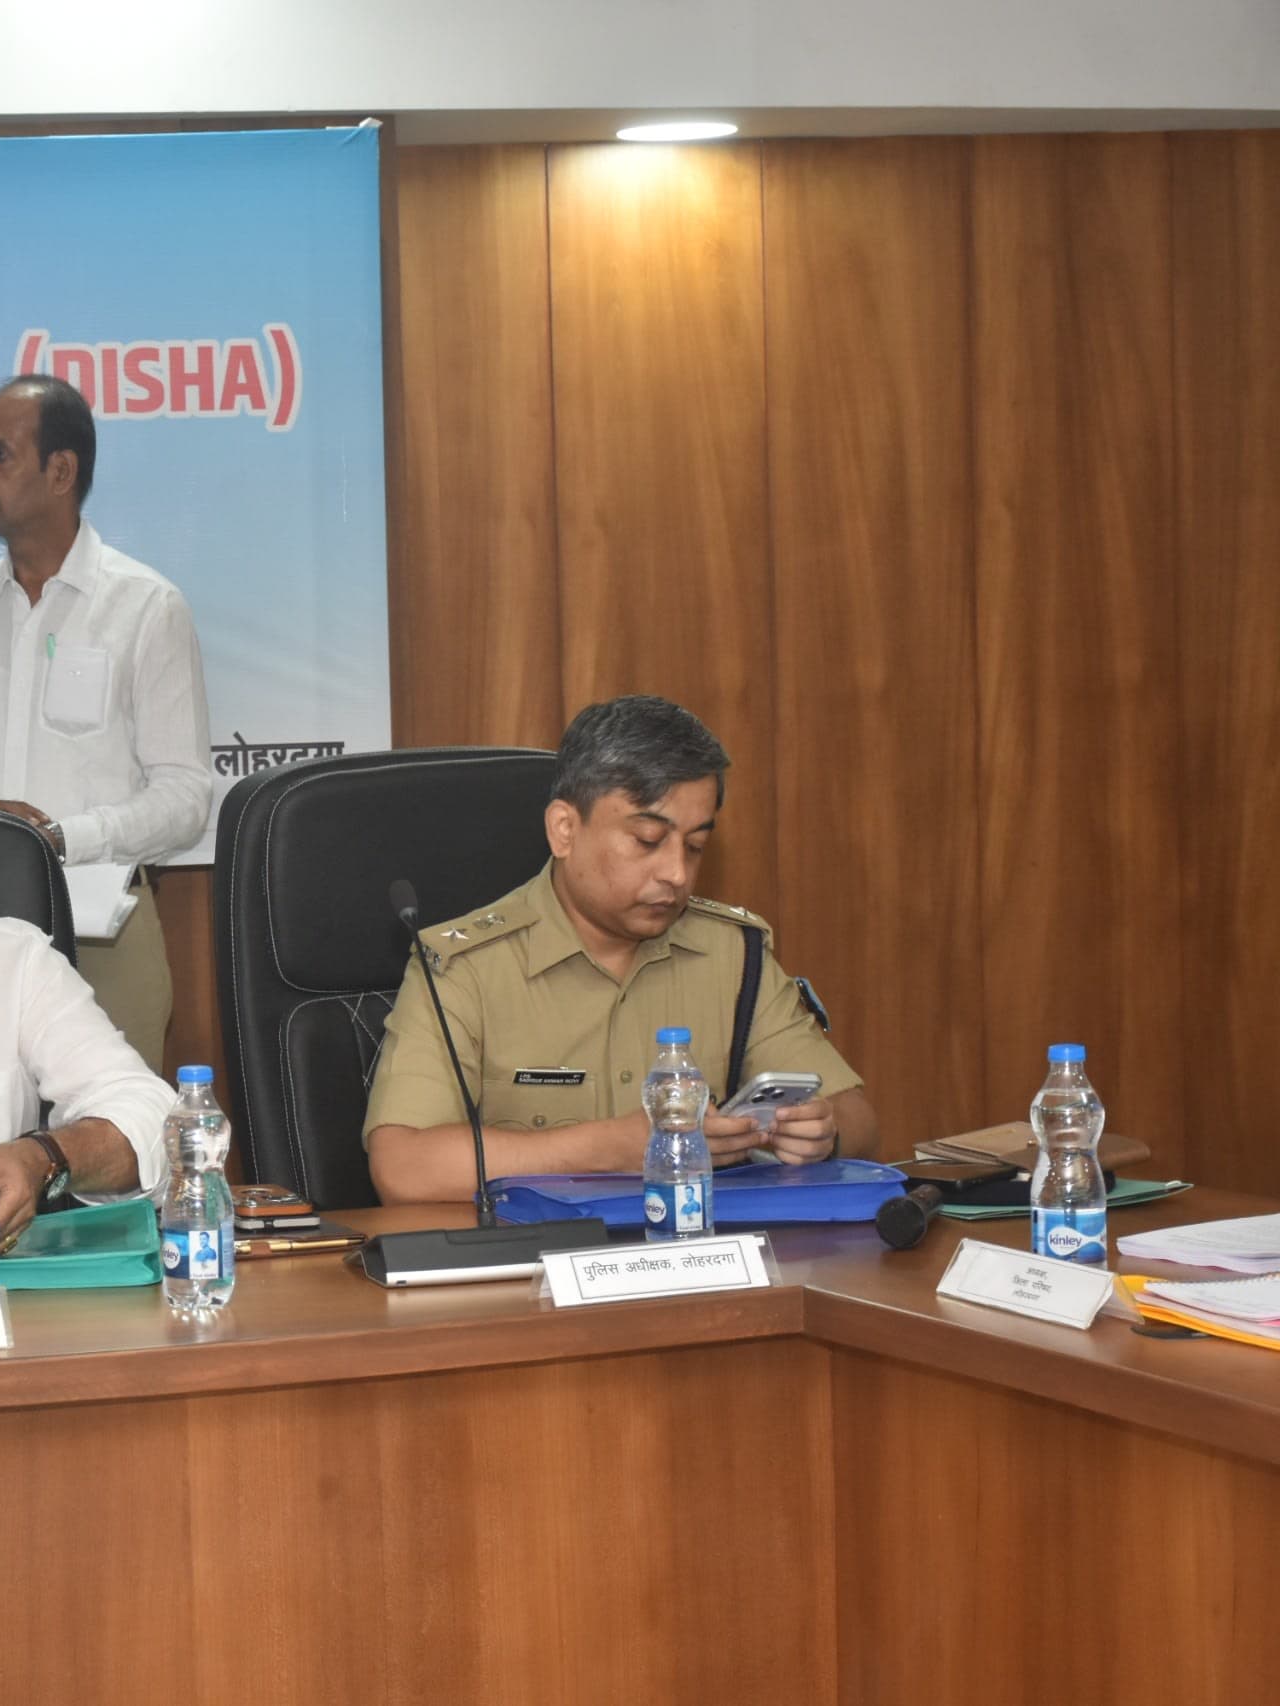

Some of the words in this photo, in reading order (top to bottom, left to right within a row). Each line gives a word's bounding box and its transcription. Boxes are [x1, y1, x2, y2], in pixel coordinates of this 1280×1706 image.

[646, 1202, 665, 1215] inley
[1049, 1234, 1082, 1247] kinley
[582, 1261, 619, 1281] पुलिस
[625, 1258, 676, 1274] अधीक्षक,
[681, 1252, 736, 1269] लोहरदगा
